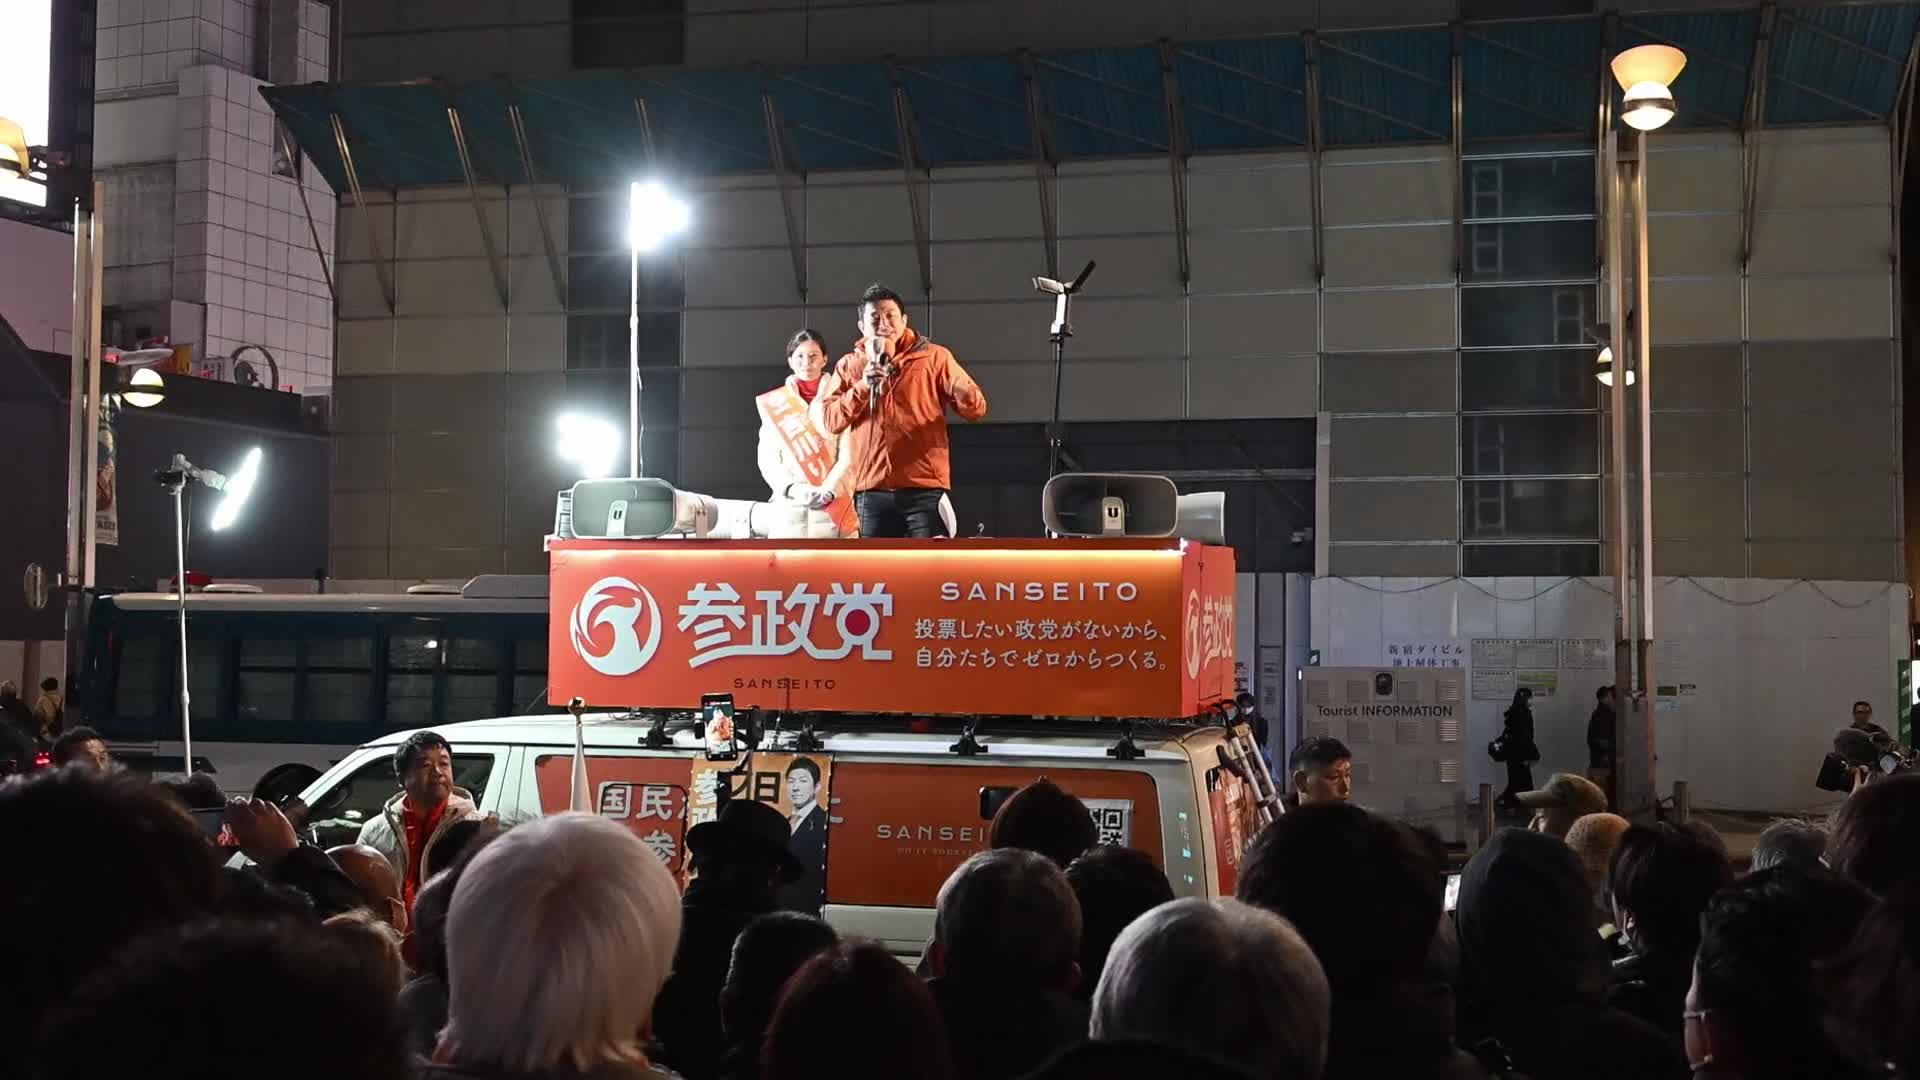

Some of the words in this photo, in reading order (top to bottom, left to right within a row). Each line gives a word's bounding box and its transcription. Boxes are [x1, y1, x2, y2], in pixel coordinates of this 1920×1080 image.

[940, 582, 1138, 601] SANSEITO
[677, 583, 893, 669] 参政党
[914, 618, 1167, 641] 投票したい政党がないから、
[915, 647, 1167, 671] 自分たちでゼロからつくる。
[733, 678, 836, 690] SANSEITO
[1317, 705, 1358, 717] Tourist
[1362, 705, 1453, 717] INFORMATION
[877, 824, 984, 842] SANSEI
